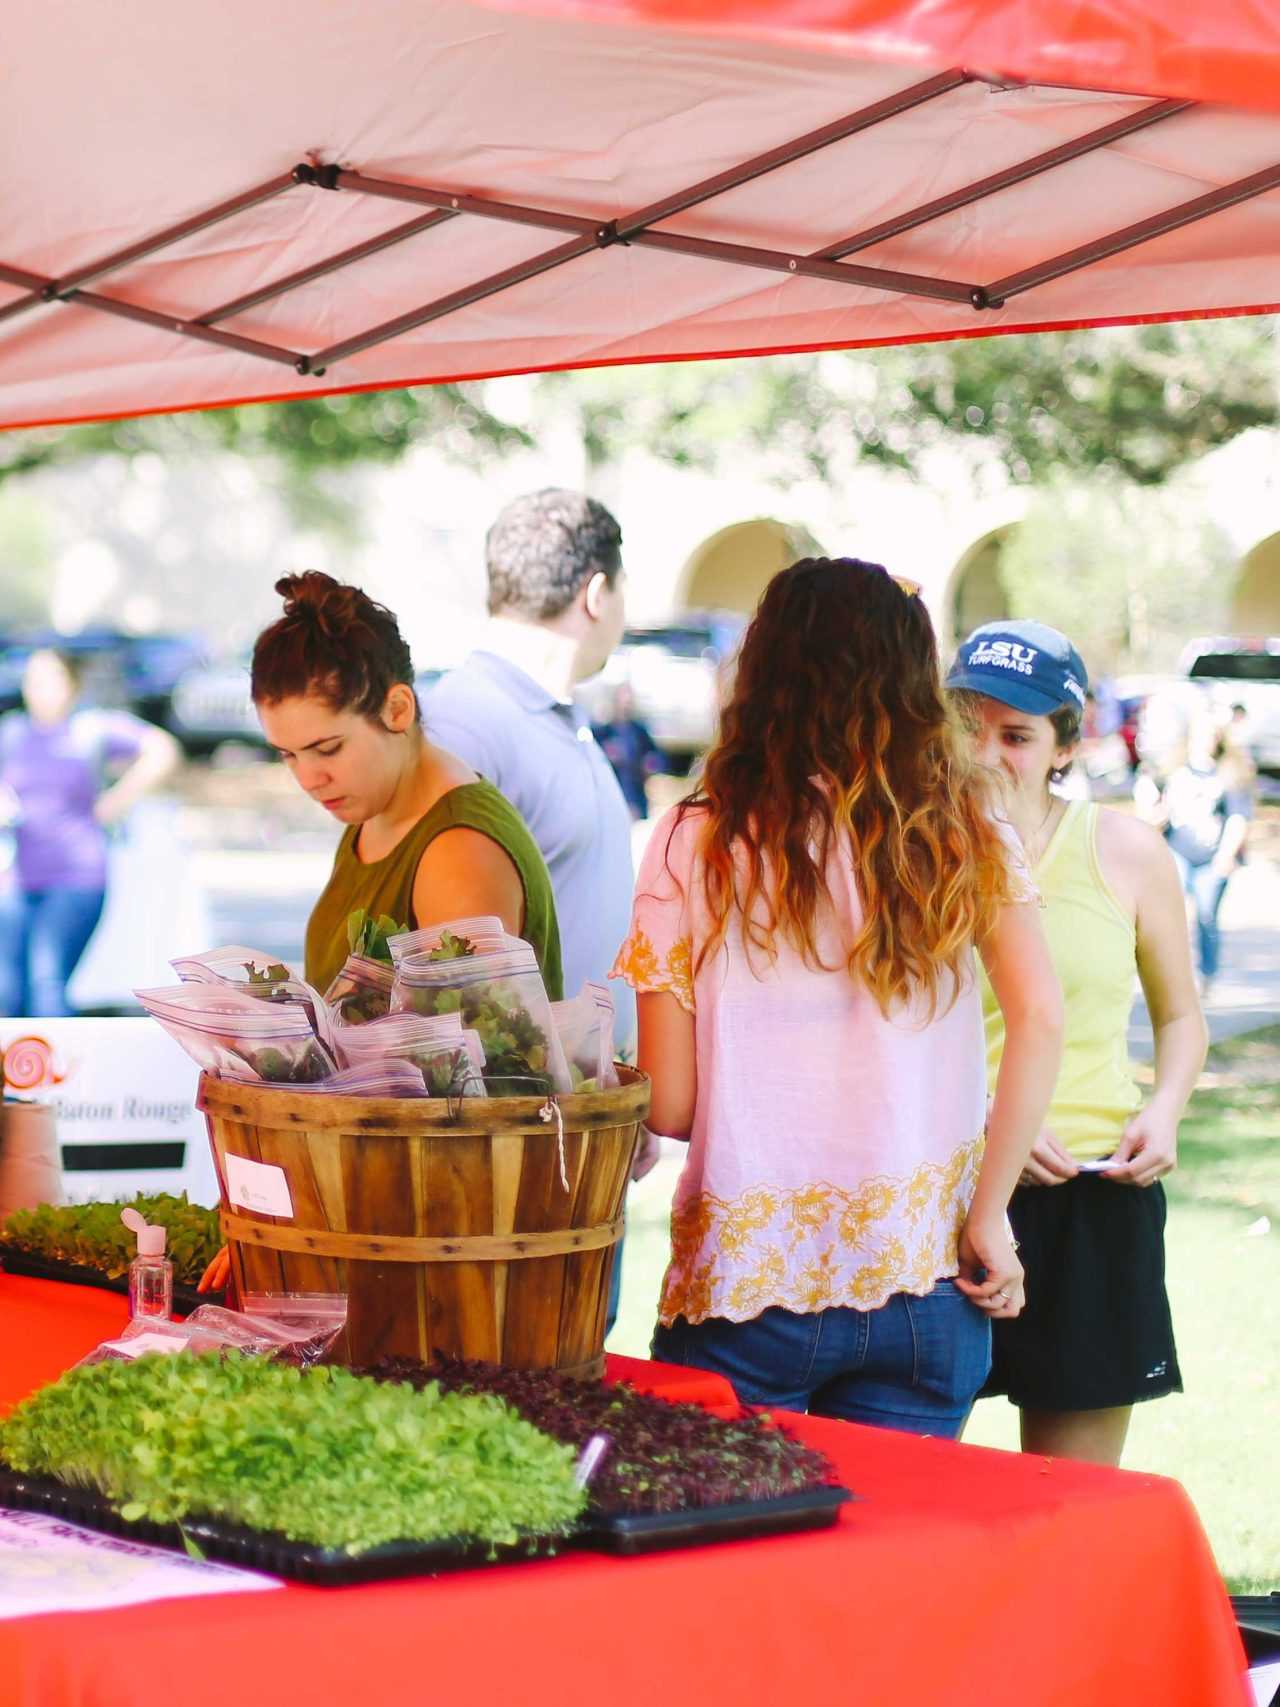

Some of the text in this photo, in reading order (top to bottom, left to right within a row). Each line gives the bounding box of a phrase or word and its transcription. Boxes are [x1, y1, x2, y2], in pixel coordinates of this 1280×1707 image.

[971, 640, 1038, 663] LSU
[968, 655, 1033, 676] TURFGRASS
[122, 1095, 192, 1125] Rouge
